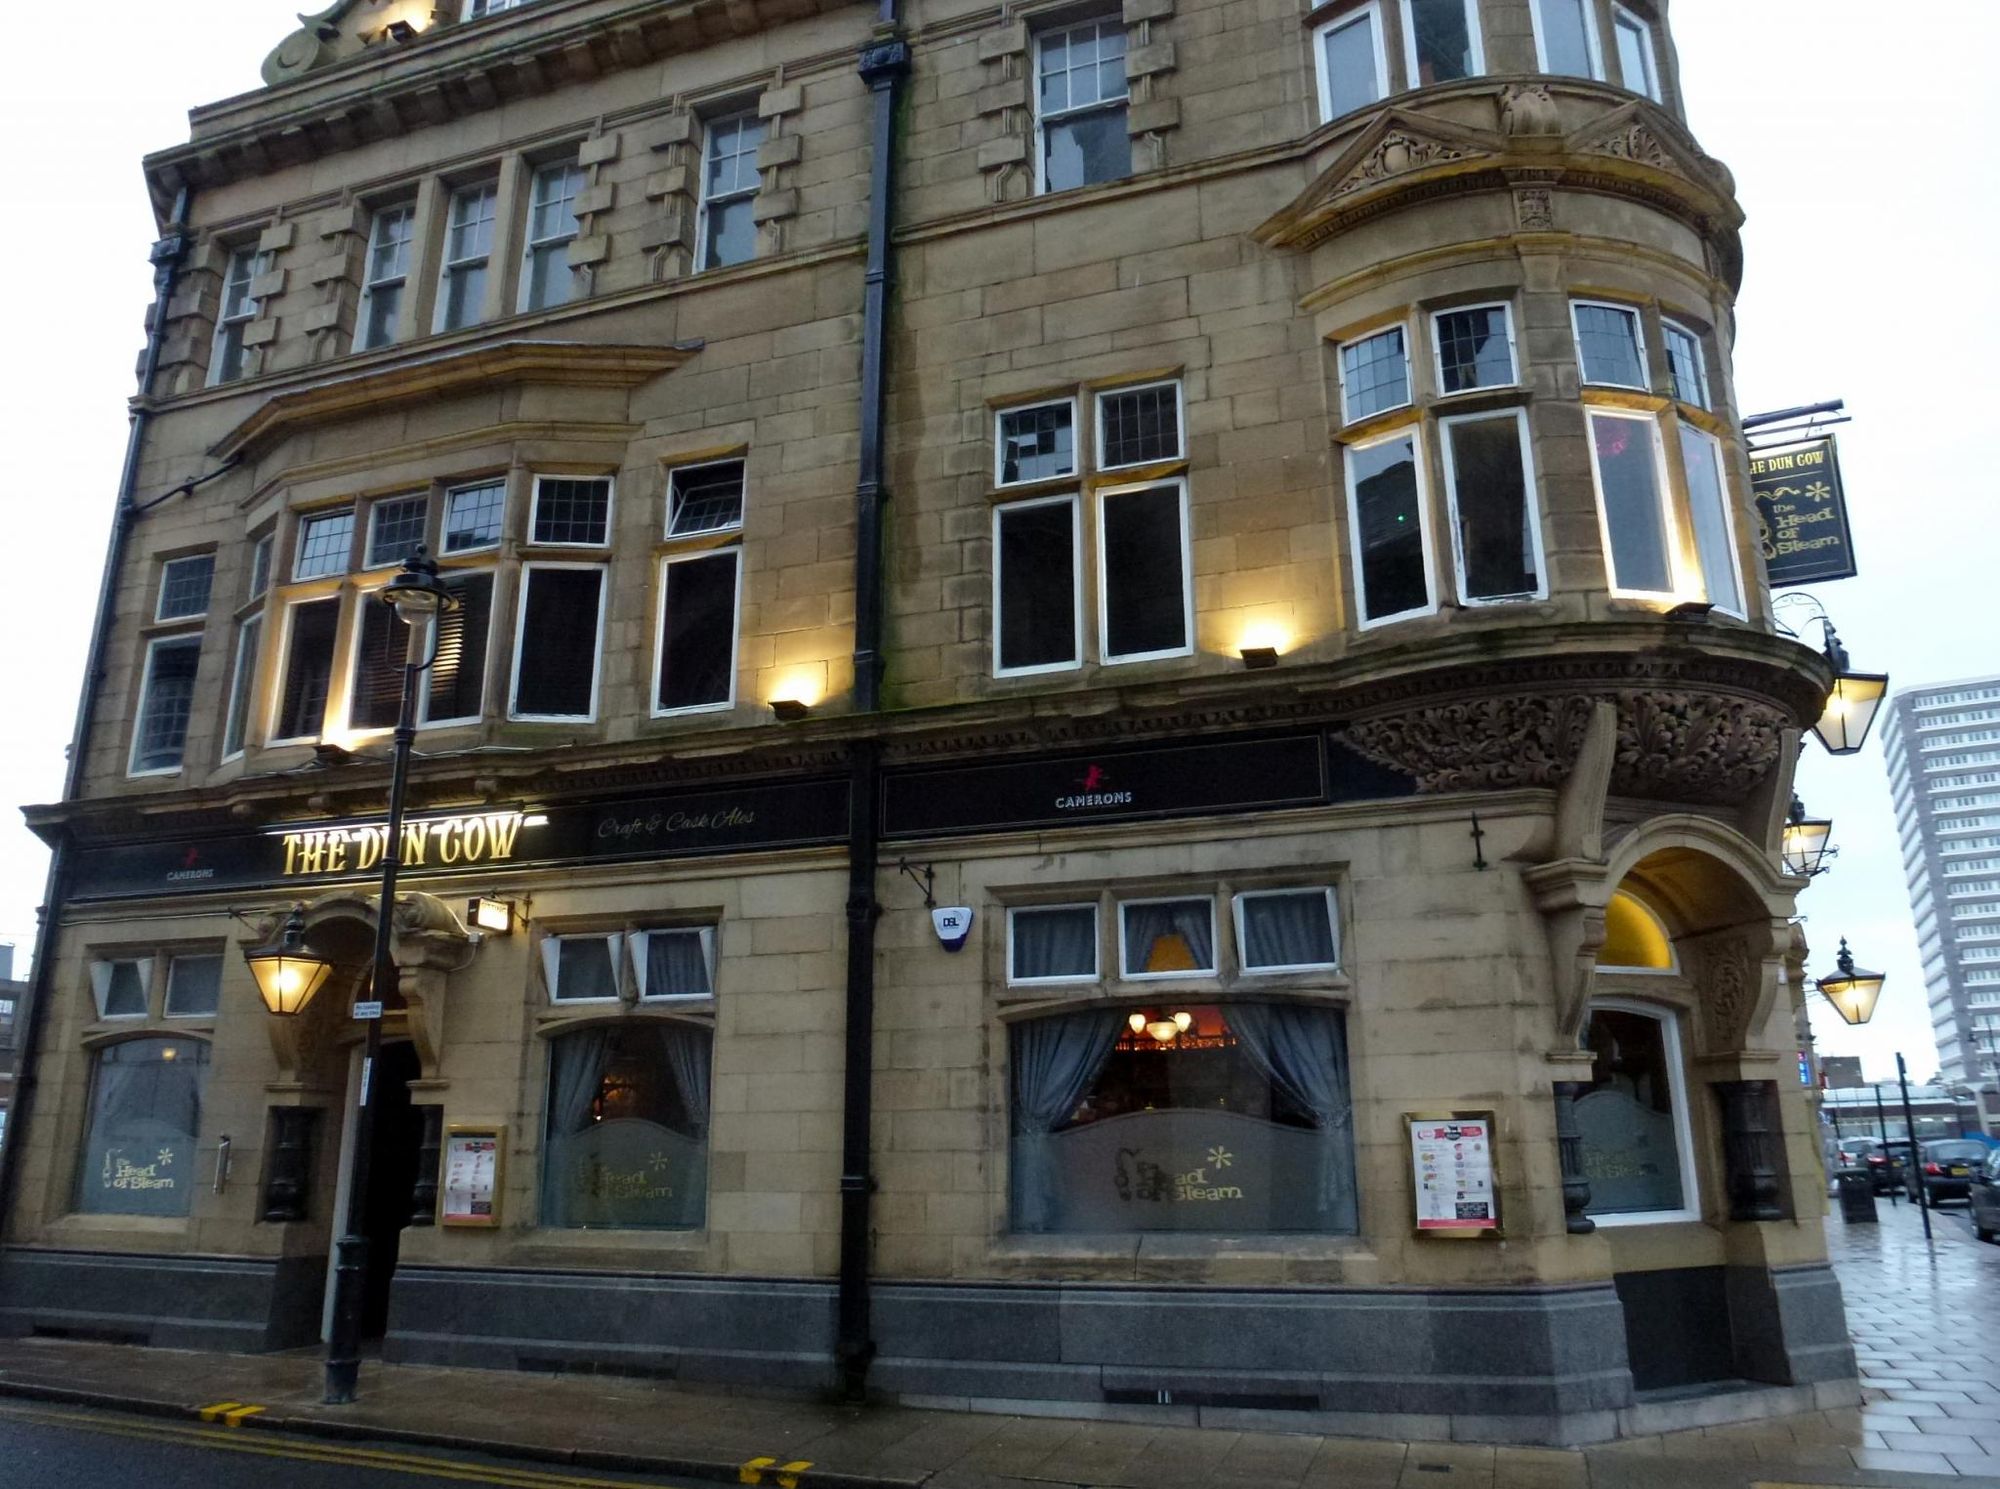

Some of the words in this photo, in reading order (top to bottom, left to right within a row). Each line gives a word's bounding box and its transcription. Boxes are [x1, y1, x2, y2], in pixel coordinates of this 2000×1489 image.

[1750, 461, 1765, 474] HE
[1768, 455, 1794, 472] DUN
[1797, 451, 1824, 467] COW
[1773, 505, 1796, 514] the
[1775, 508, 1835, 529] Head
[1777, 528, 1800, 539] of
[1777, 536, 1840, 554] Steam
[1055, 792, 1132, 808] CAMERONS
[598, 817, 643, 839] Craft
[666, 811, 709, 832] Cask
[711, 807, 755, 829] Ales
[282, 829, 350, 875] THE
[439, 813, 524, 863] COW
[115, 1164, 157, 1178] Head
[130, 1176, 175, 1190] Steam
